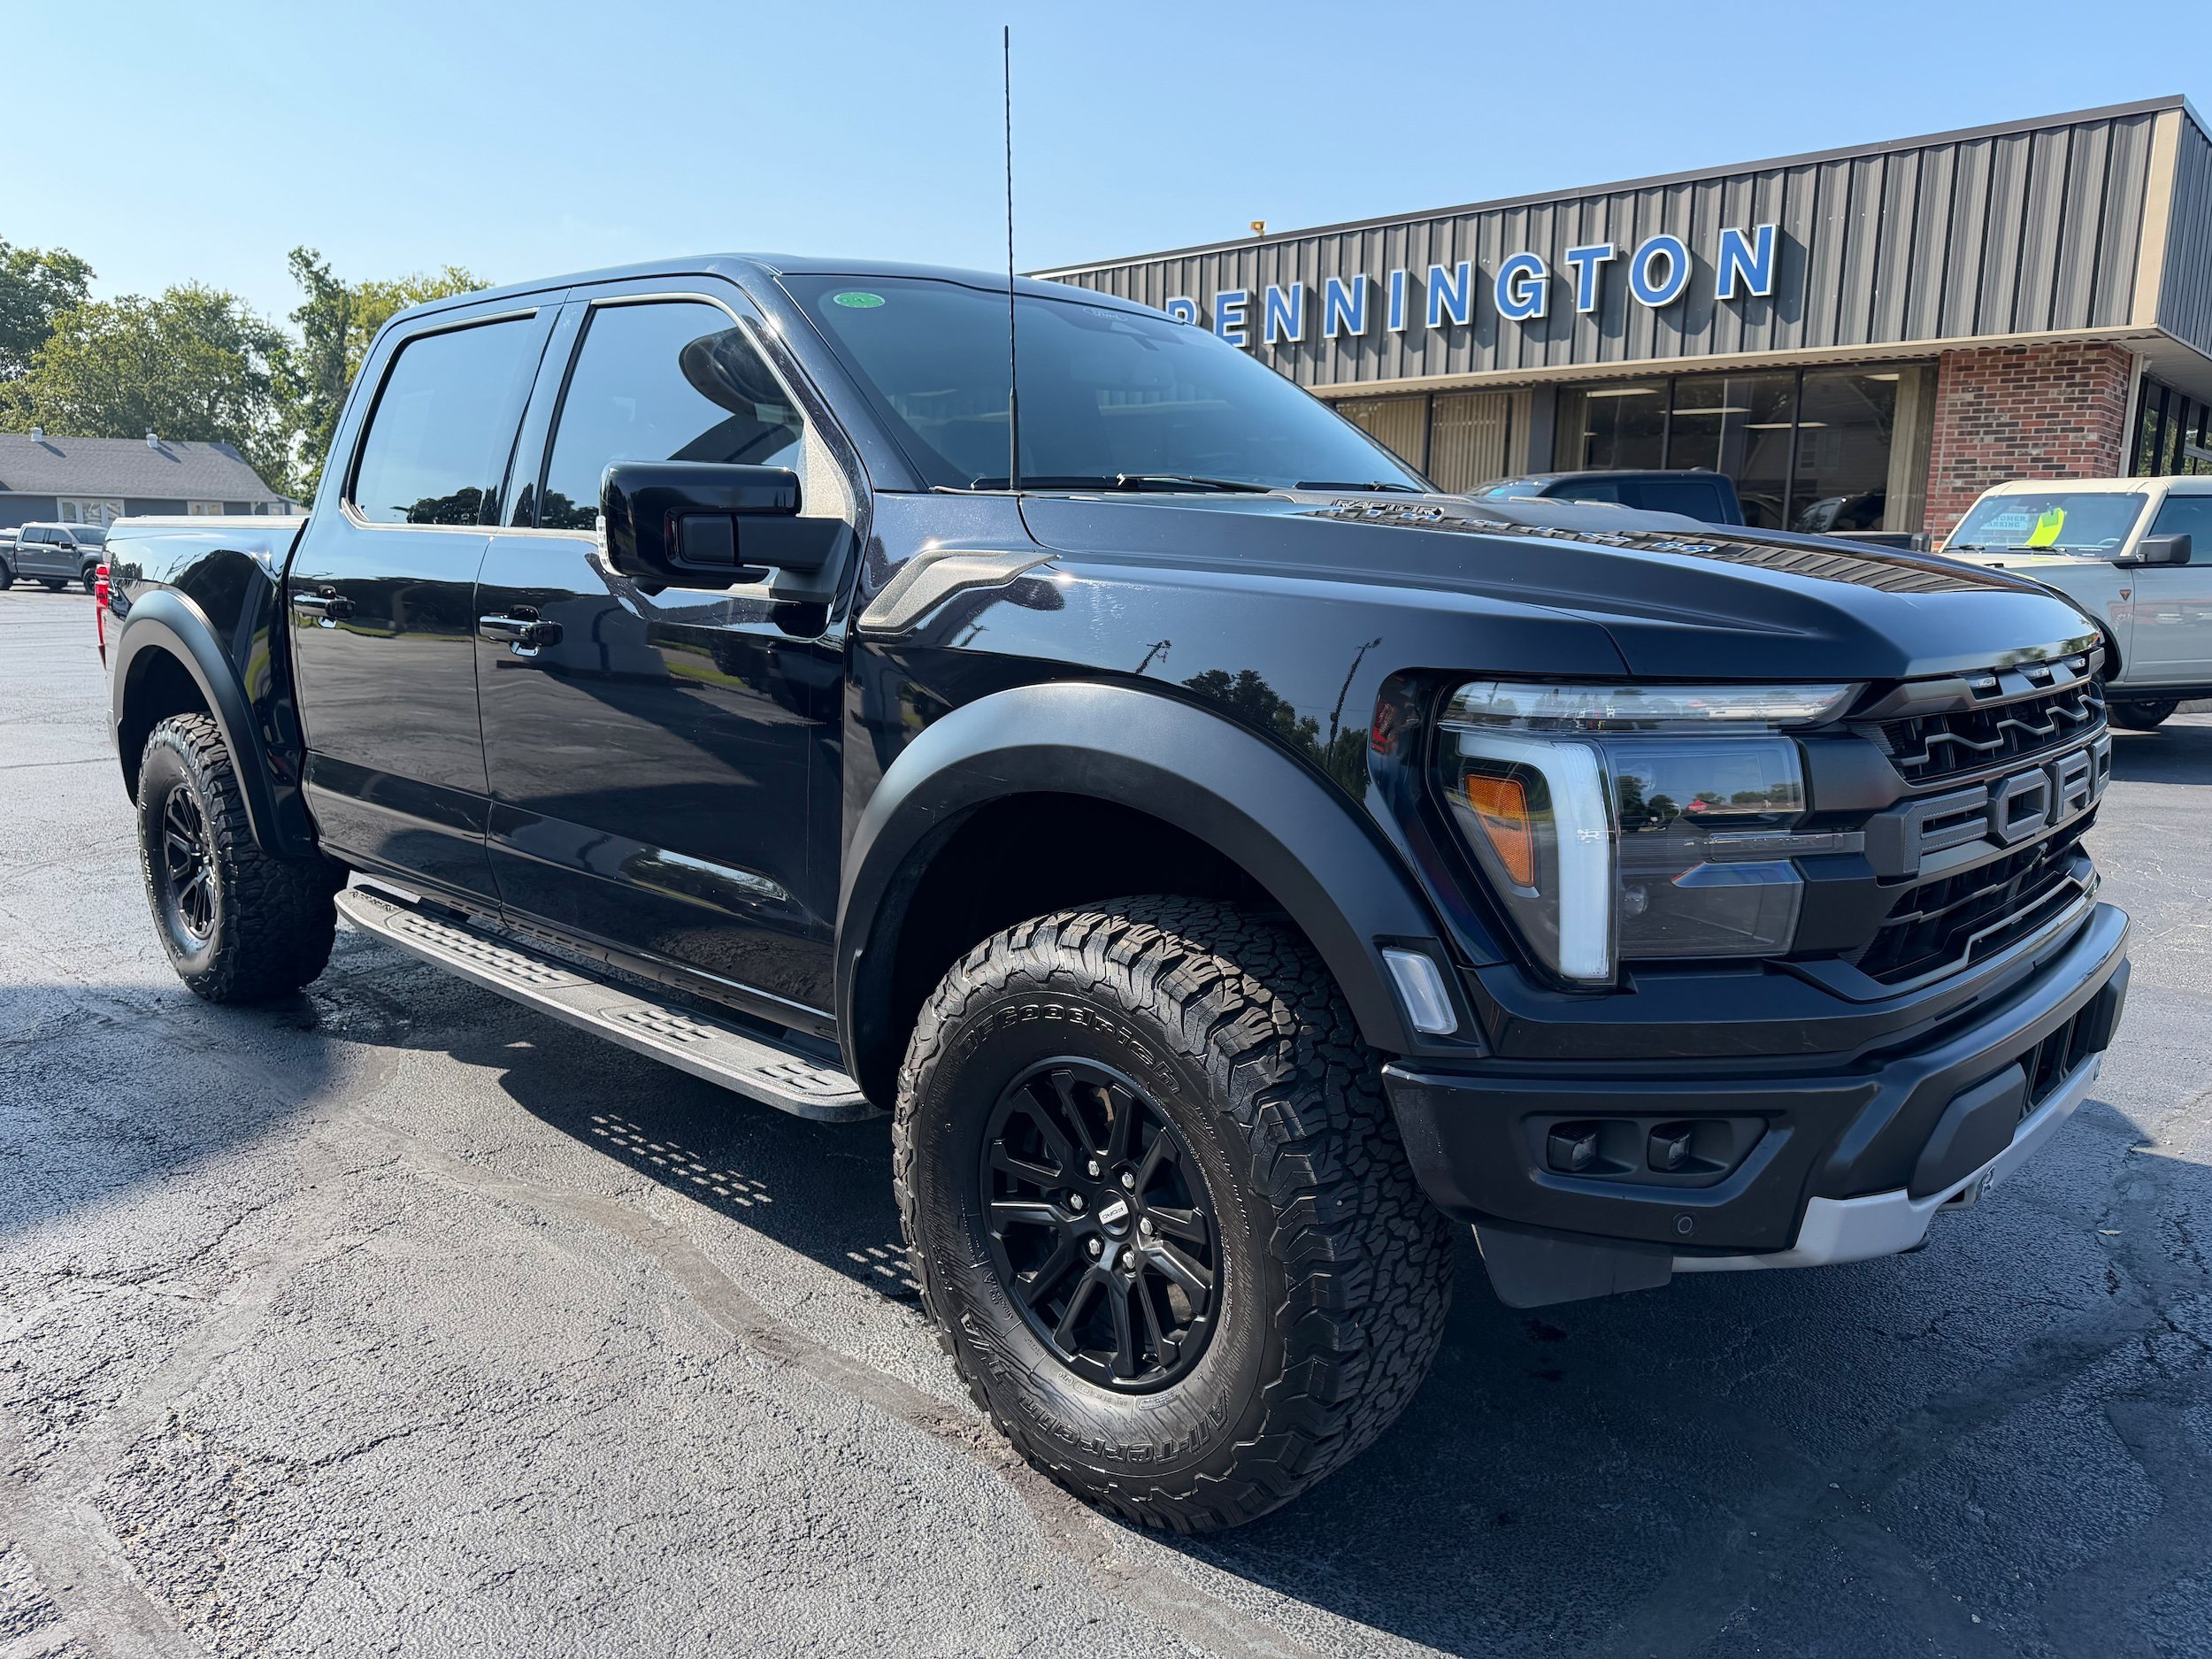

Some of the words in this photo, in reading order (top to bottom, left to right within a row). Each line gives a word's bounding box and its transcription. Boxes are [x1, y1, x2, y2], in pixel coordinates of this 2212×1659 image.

[1331, 498, 1441, 517] RAPTOR
[1901, 732, 2112, 874] FORD
[1102, 1207, 1125, 1219] FORD
